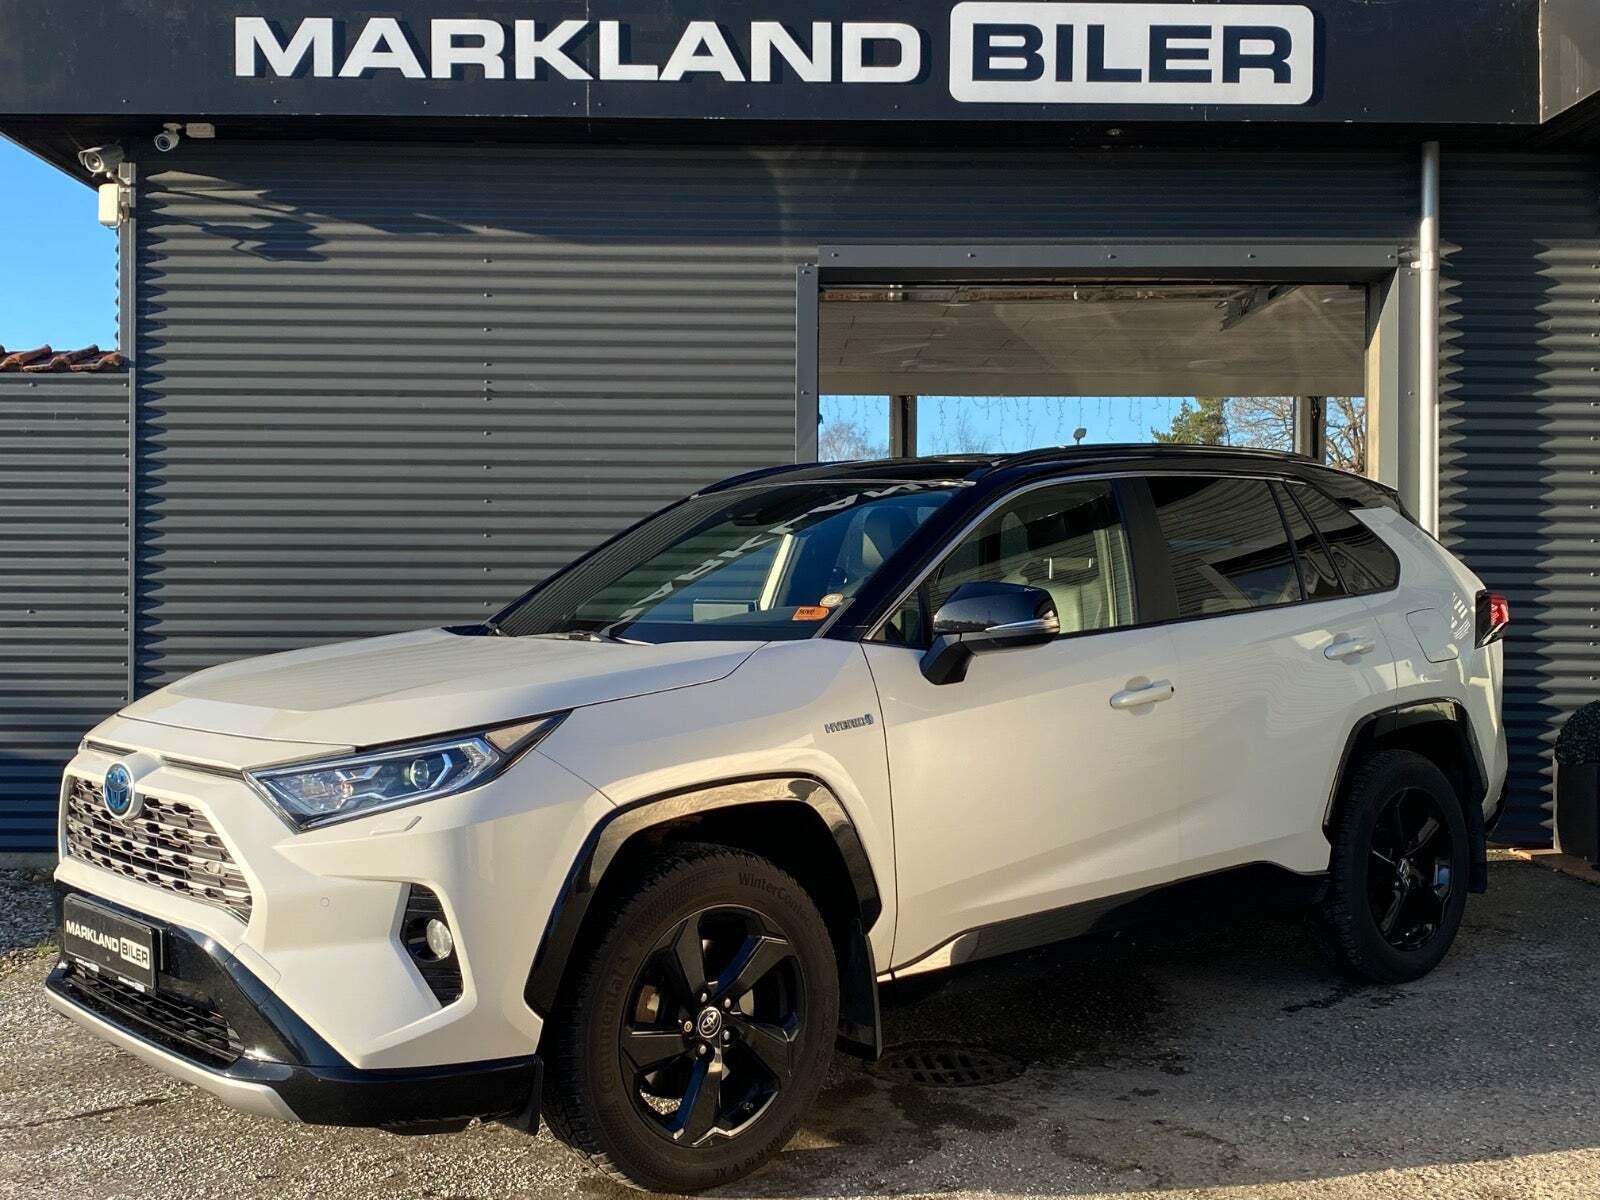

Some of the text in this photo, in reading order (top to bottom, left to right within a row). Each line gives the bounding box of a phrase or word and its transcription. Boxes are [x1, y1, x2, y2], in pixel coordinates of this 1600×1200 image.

[234, 16, 1292, 83] MARKLAND BILER
[66, 919, 148, 964] MARKLAND BILER
